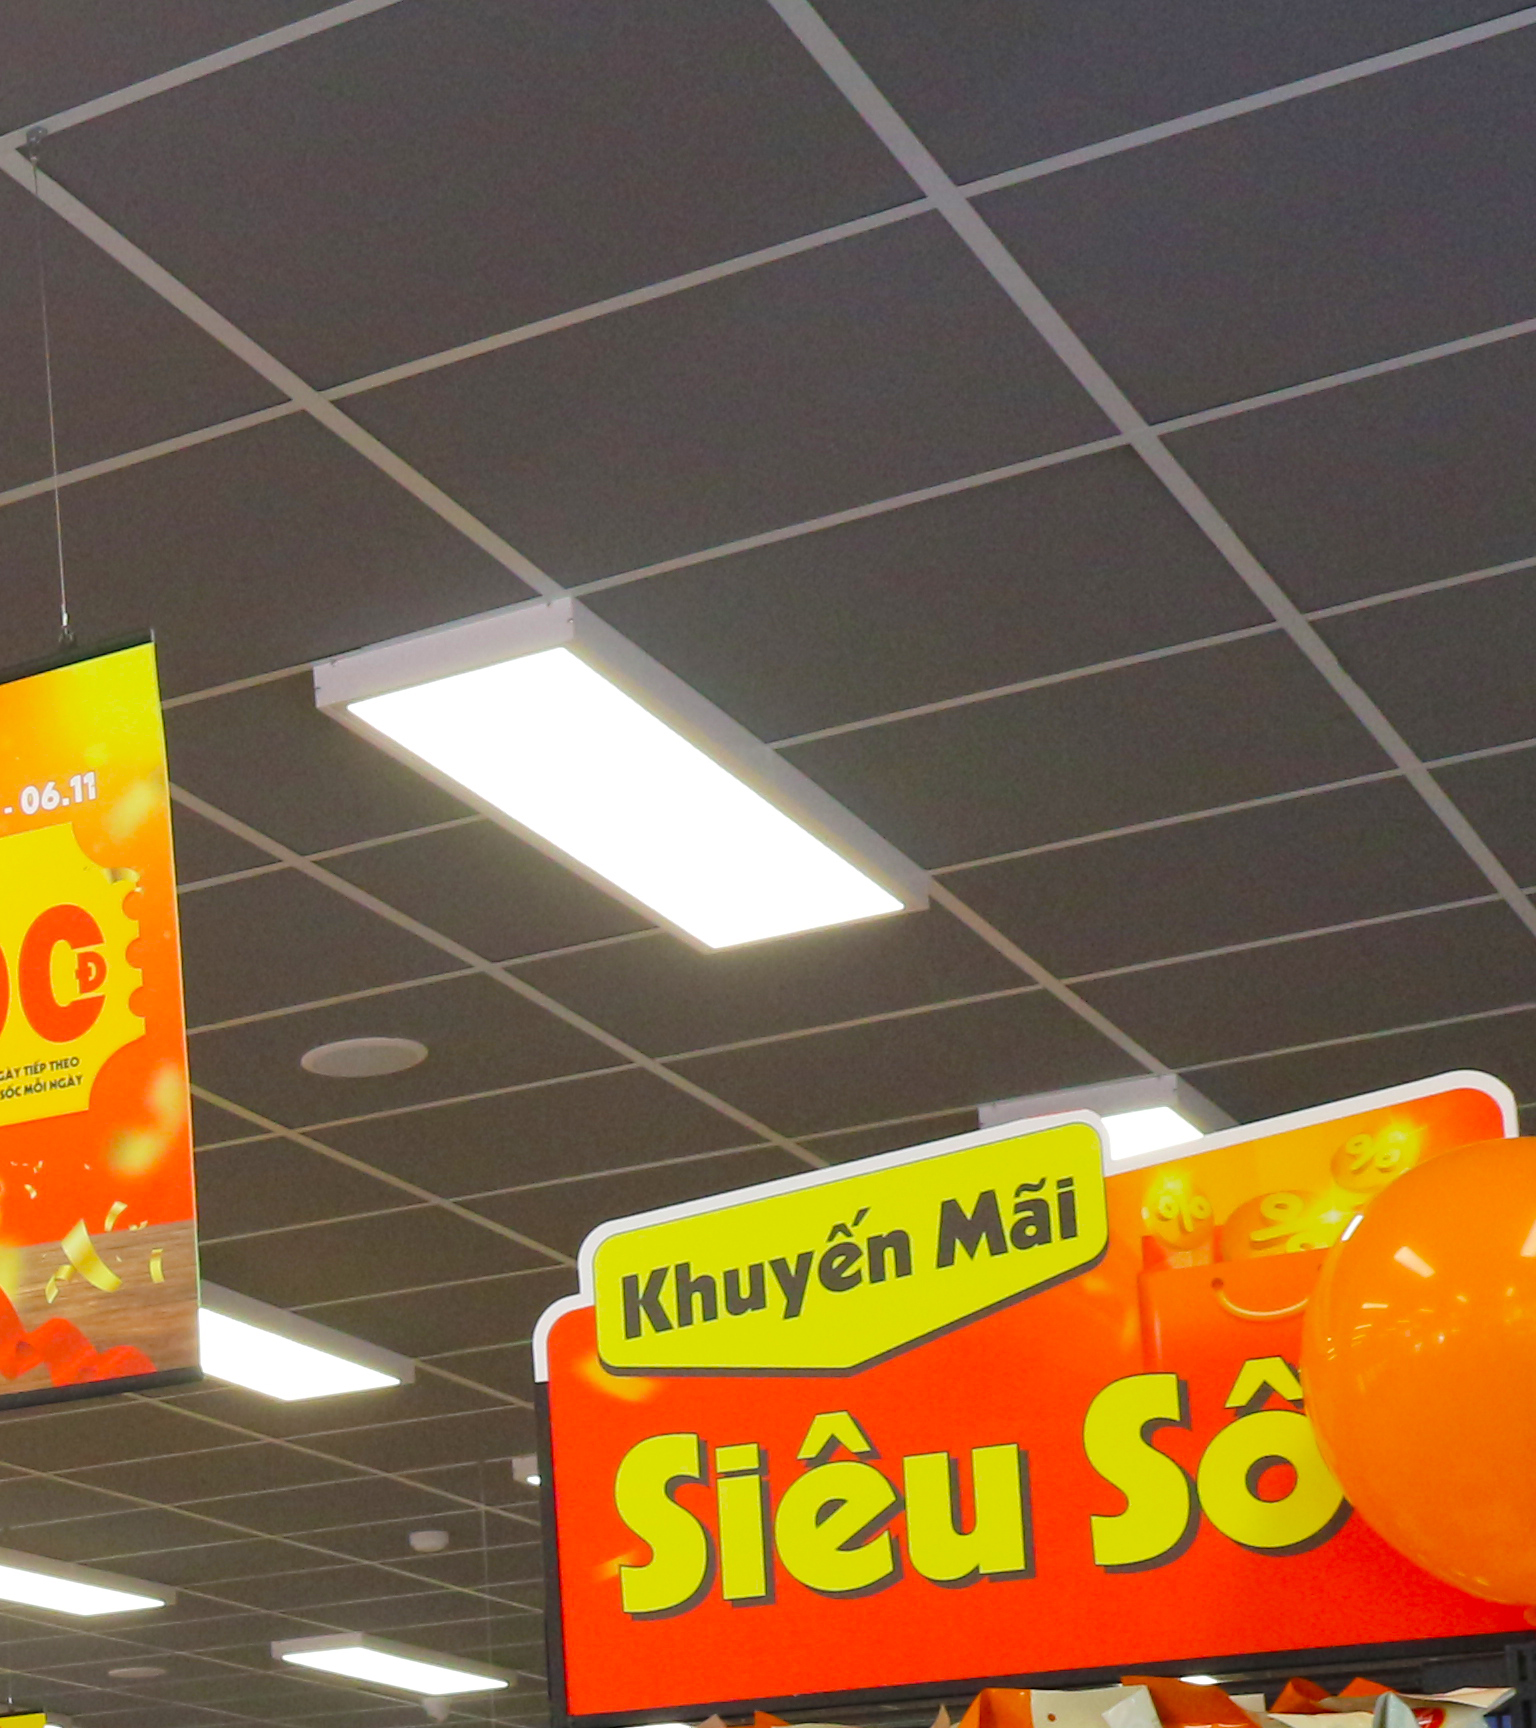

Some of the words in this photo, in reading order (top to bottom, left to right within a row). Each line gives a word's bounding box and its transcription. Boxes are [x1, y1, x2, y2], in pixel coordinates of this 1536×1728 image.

[21, 771, 97, 814] 06.11
[24, 1061, 46, 1076] TIẾP
[50, 1057, 79, 1071] THEO
[621, 1208, 911, 1339] Khuyến
[936, 1178, 1077, 1267] Mãi
[615, 1411, 1030, 1615] Siêu
